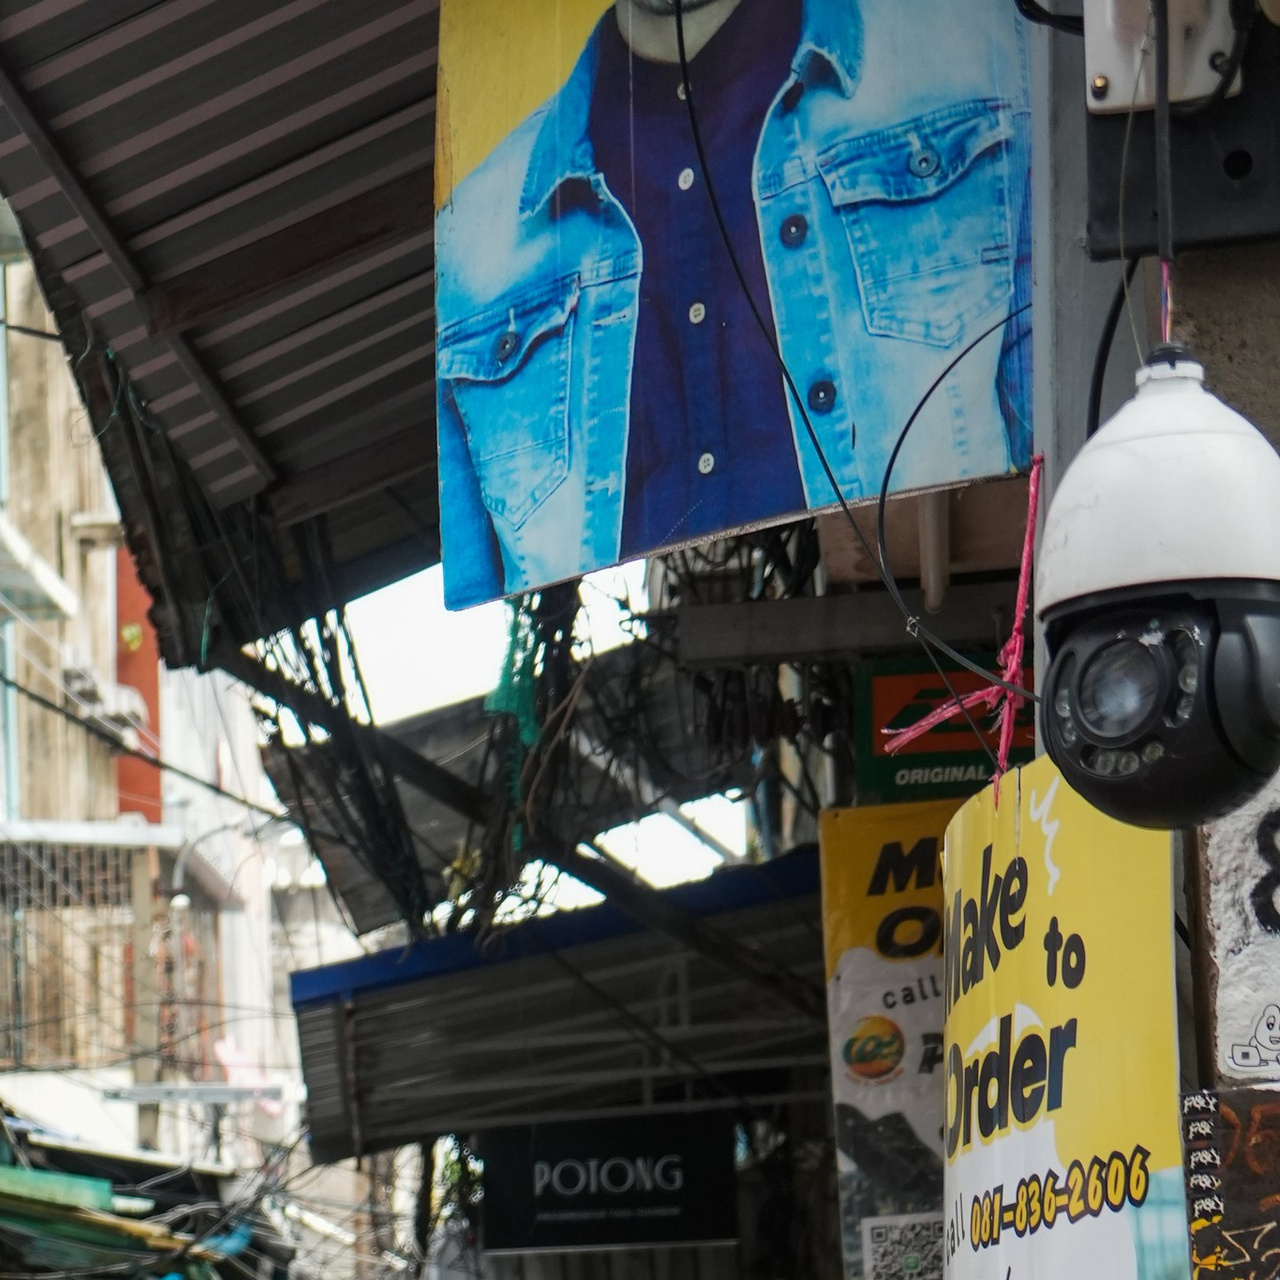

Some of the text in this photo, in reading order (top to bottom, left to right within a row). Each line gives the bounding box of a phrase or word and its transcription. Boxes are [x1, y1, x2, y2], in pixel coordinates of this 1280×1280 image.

[895, 765, 988, 786] ORIGINAL
[866, 836, 944, 896] M
[875, 906, 944, 959] O
[1044, 916, 1086, 989] to
[882, 976, 942, 1009] call
[945, 1013, 1078, 1159] Order
[533, 1154, 685, 1196] POTONG
[971, 1147, 1149, 1249] 081-836-2606
